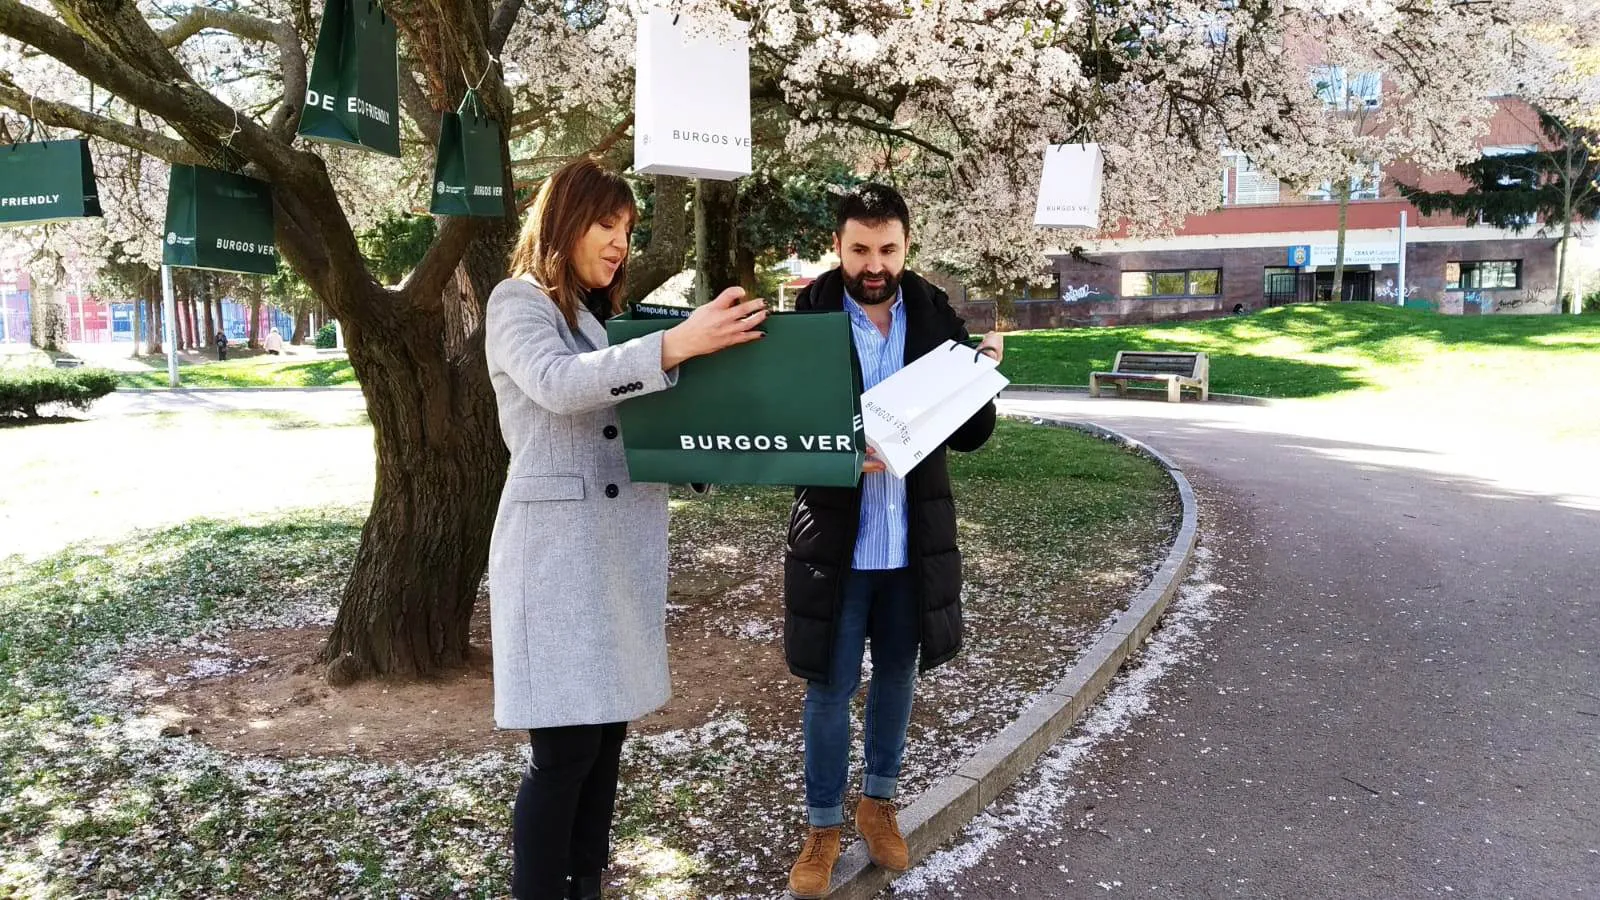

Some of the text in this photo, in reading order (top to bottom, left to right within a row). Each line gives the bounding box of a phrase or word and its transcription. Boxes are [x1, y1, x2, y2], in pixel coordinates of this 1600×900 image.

[306, 90, 335, 112] DE
[673, 129, 728, 145] BURGOS
[1, 194, 59, 206] FRIENDLY
[216, 238, 275, 256] BURGOS VER
[669, 308, 679, 316] de
[865, 401, 895, 422] BURGOS
[680, 434, 852, 451] BURGOS VER
